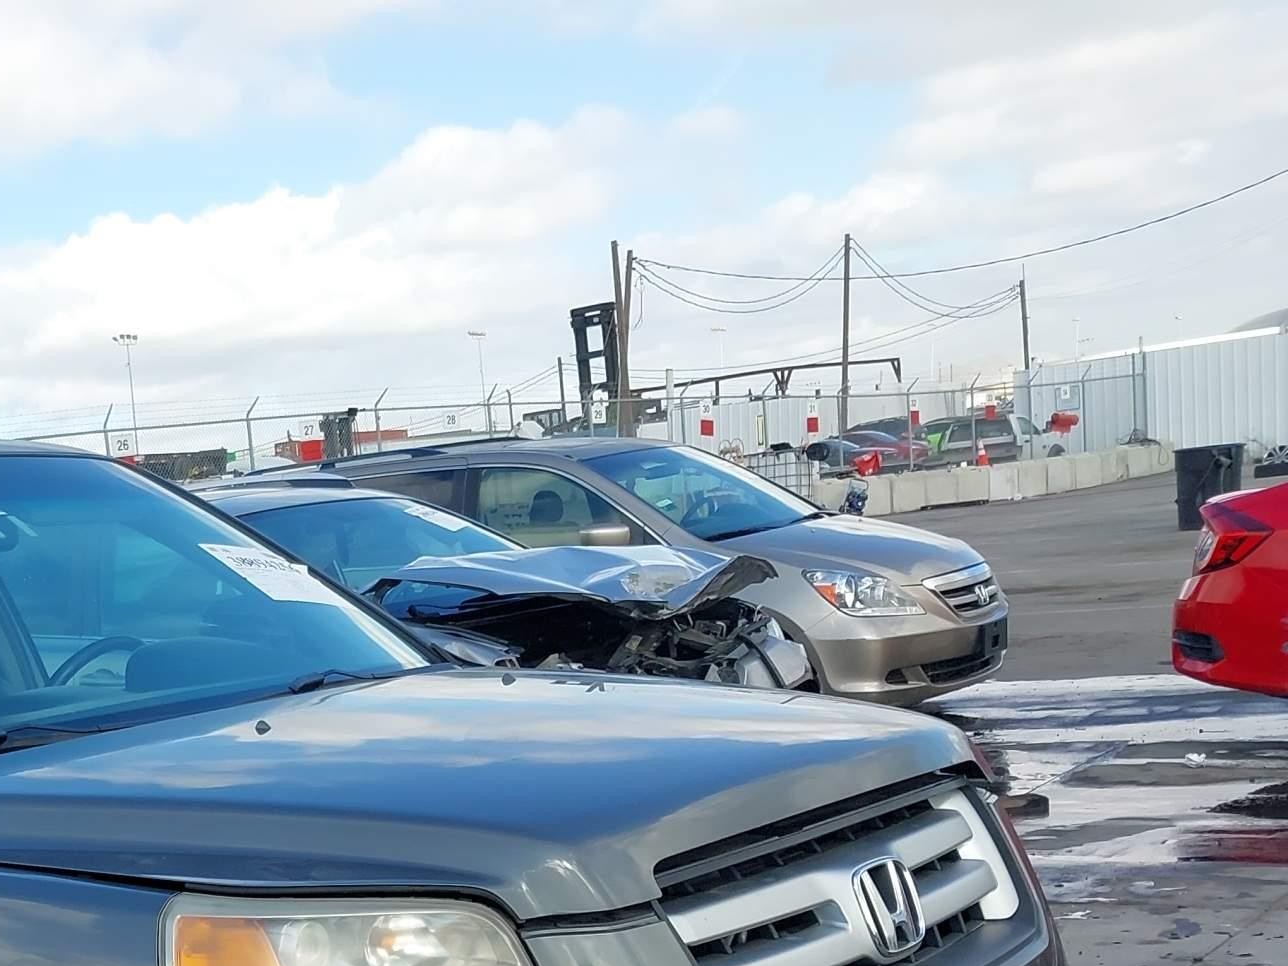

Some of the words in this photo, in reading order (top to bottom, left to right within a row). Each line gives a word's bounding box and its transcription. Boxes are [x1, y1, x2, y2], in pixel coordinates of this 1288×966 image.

[594, 410, 602, 419] 29
[447, 415, 456, 425] 28
[304, 425, 313, 435] 27
[117, 439, 128, 451] 26
